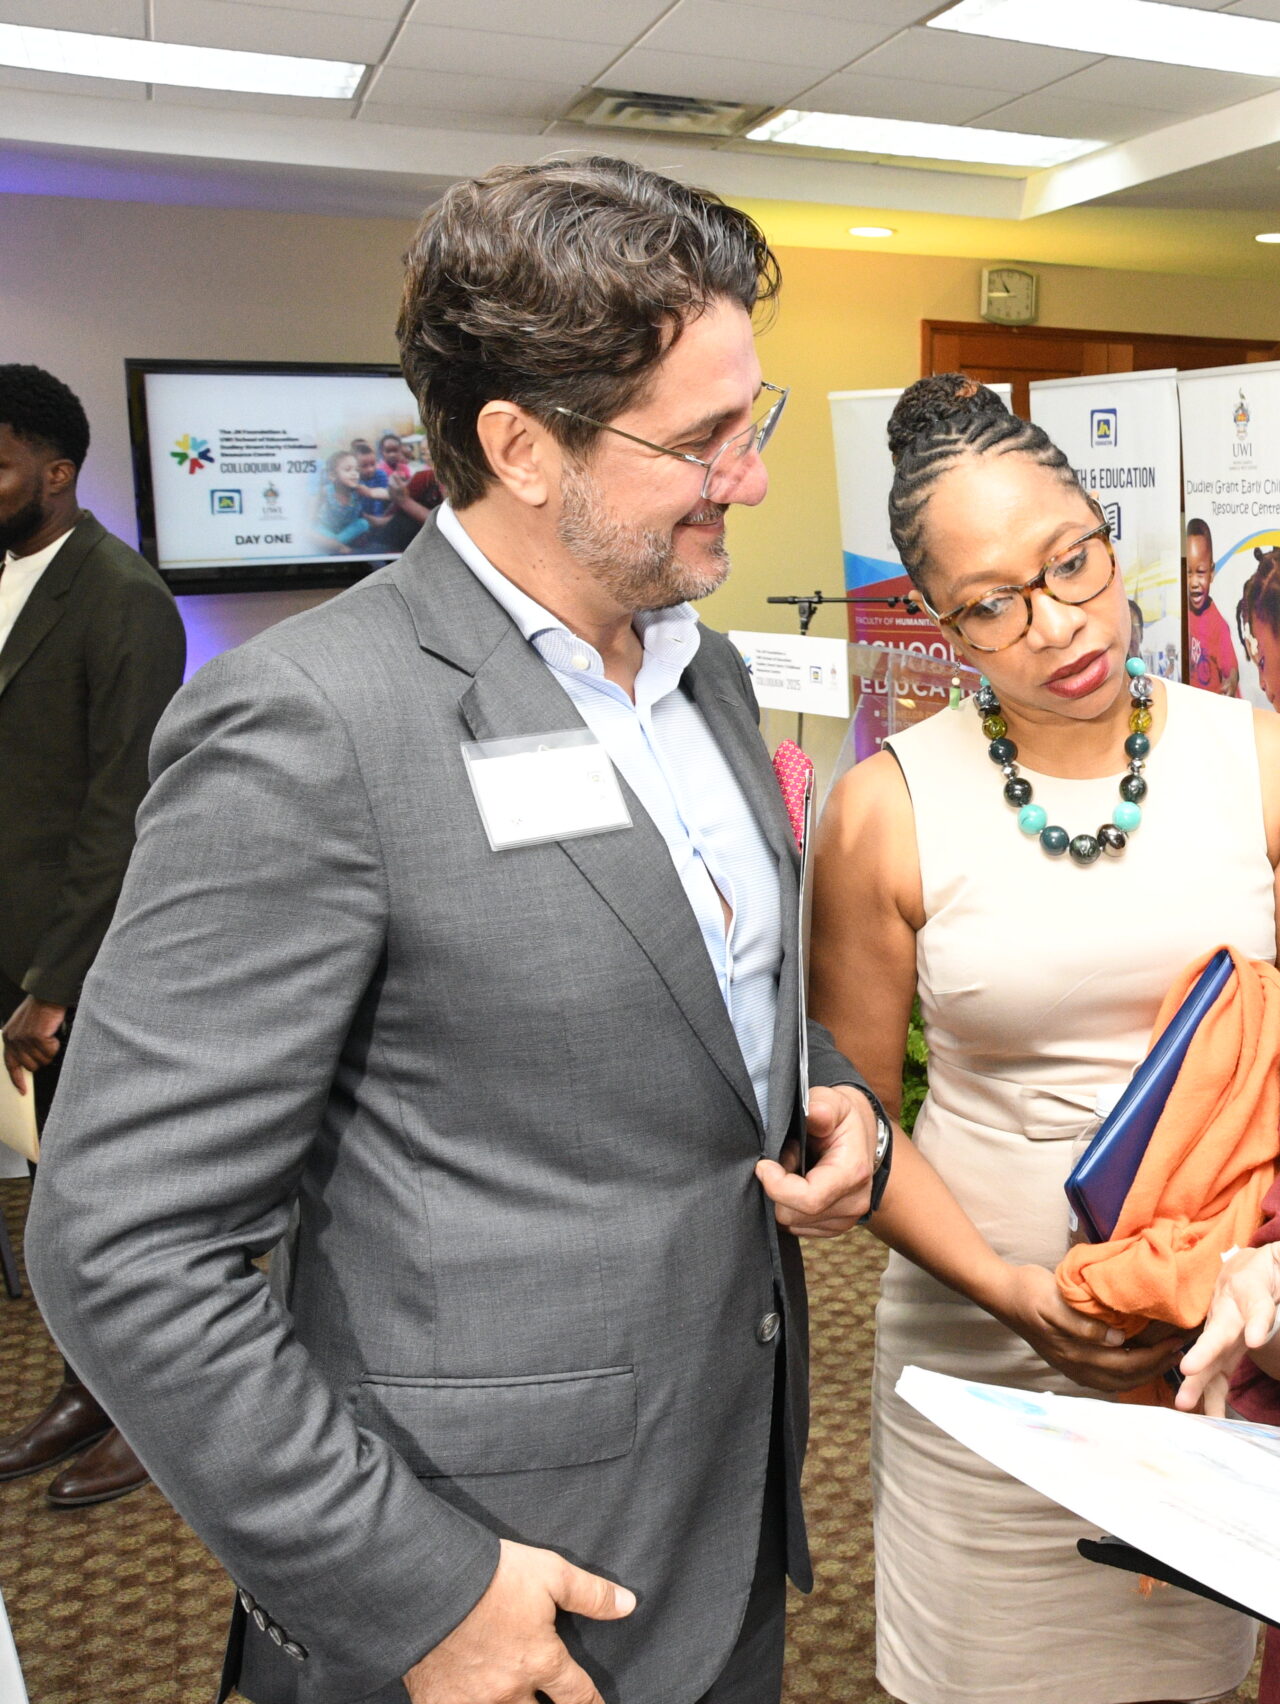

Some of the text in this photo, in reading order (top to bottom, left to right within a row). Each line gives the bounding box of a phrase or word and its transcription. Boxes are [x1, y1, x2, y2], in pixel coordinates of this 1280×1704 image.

[1232, 442, 1252, 458] UWI
[286, 460, 317, 474] 2025
[1090, 468, 1097, 489] &
[1099, 466, 1156, 489] EDUCATION
[1186, 480, 1213, 495] Dudley
[1215, 480, 1239, 494] Grant
[1241, 480, 1261, 494] Early
[1211, 501, 1280, 517] Resource Centre
[234, 533, 293, 545] DAY ONE
[884, 617, 895, 626] OF
[895, 617, 937, 627] HUMANIT
[857, 639, 960, 668] HOOL
